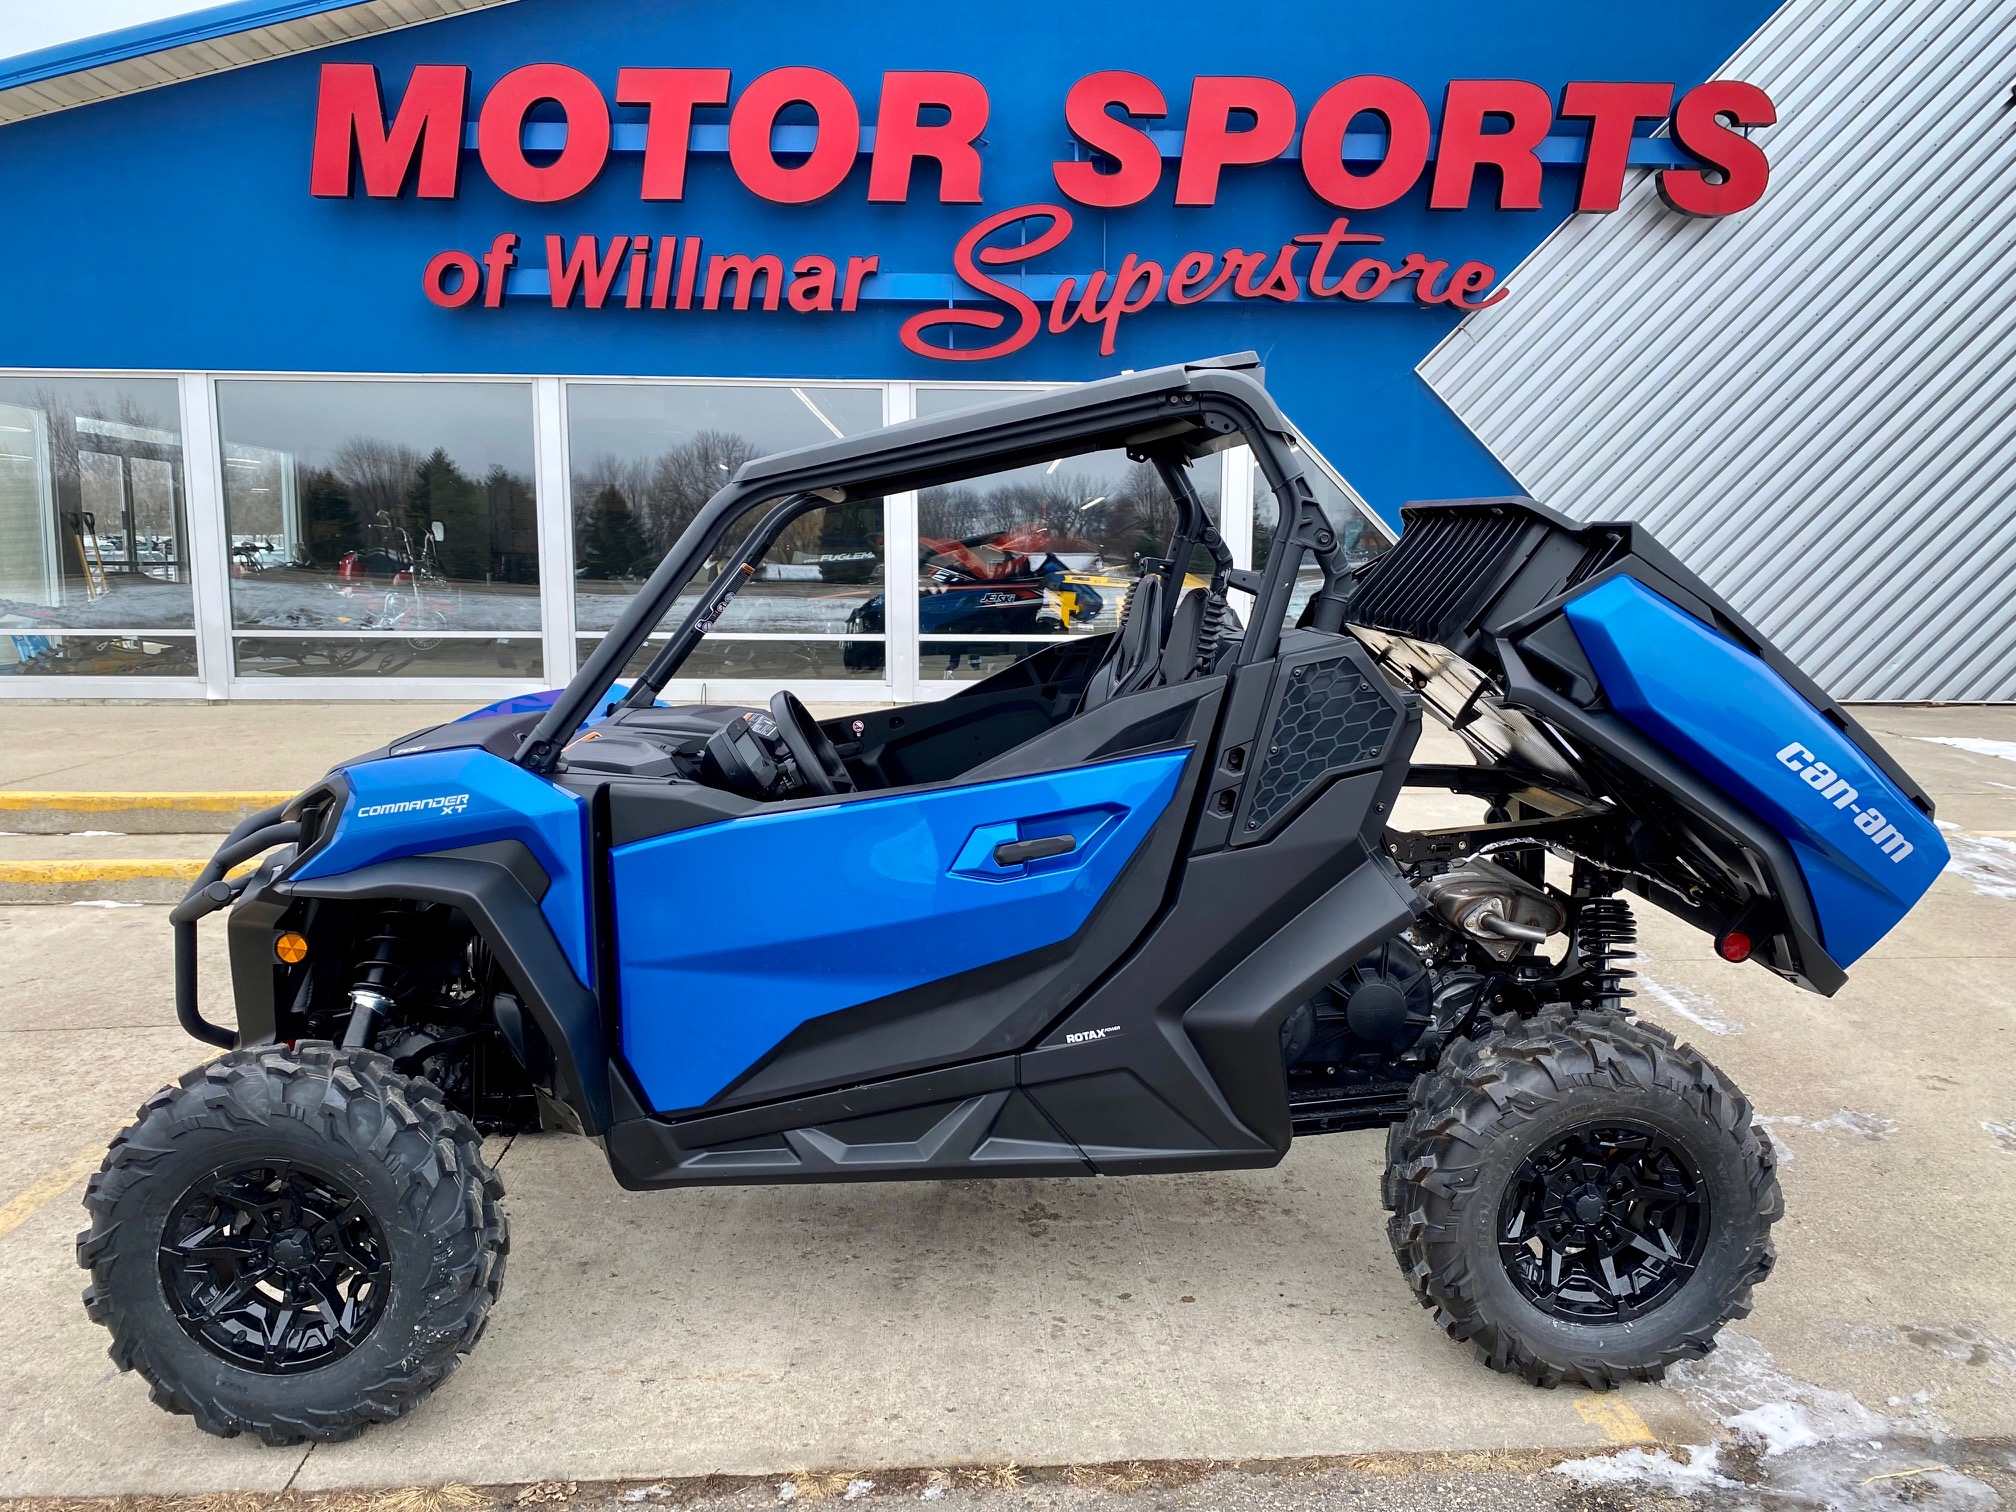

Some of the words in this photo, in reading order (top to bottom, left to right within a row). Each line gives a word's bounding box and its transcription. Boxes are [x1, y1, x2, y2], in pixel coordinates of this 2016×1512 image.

[310, 63, 990, 204] MOTOR
[1053, 71, 1777, 216] SPORTS
[423, 232, 520, 309] of
[546, 234, 880, 312] Willmar
[899, 204, 1509, 361] Superstore
[358, 794, 470, 817] COMMANDER
[440, 804, 468, 815] XT
[1777, 741, 1914, 864] can-am
[1066, 1028, 1106, 1044] ROTAX
